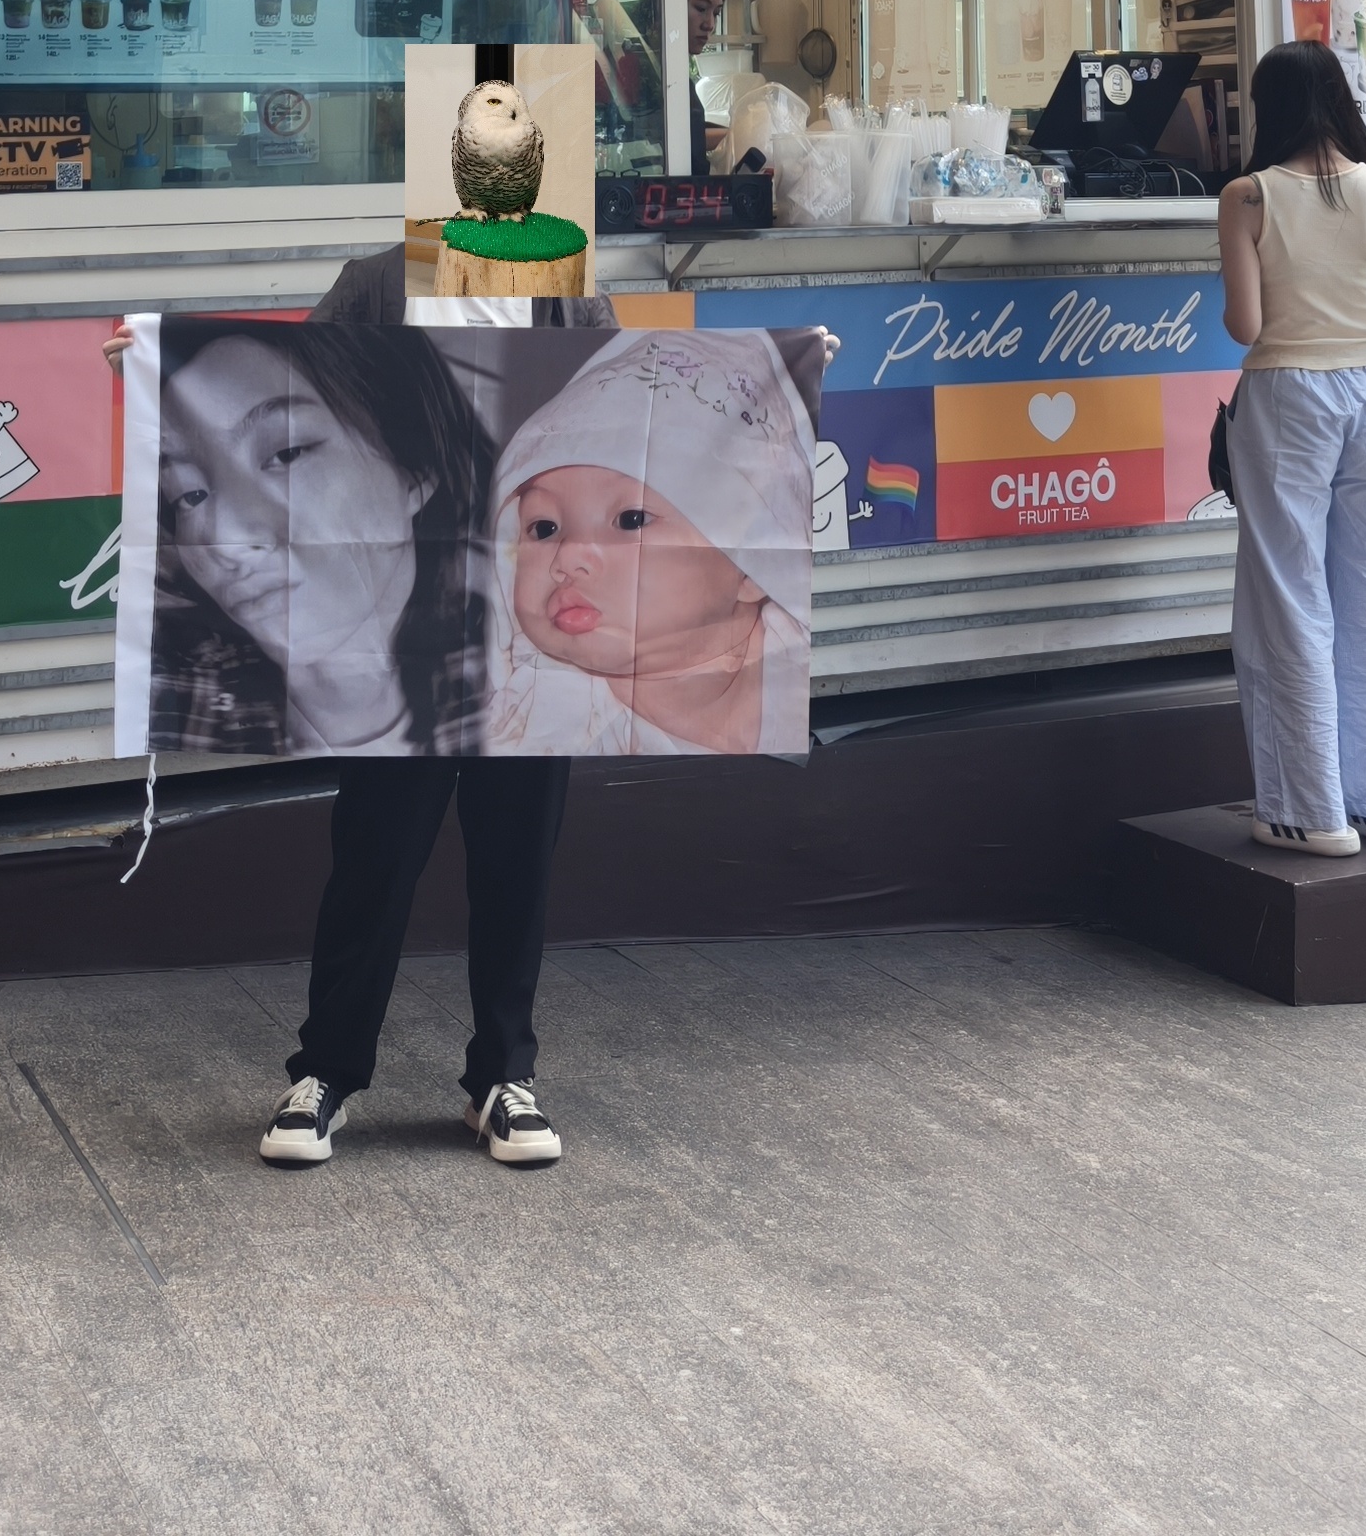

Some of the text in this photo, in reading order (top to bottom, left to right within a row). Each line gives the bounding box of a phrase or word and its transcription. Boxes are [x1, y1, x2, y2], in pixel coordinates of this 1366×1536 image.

[874, 290, 1201, 385] Pride Month
[990, 457, 1116, 510] CHAGÔ
[1018, 505, 1090, 526] FRUIT TEA
